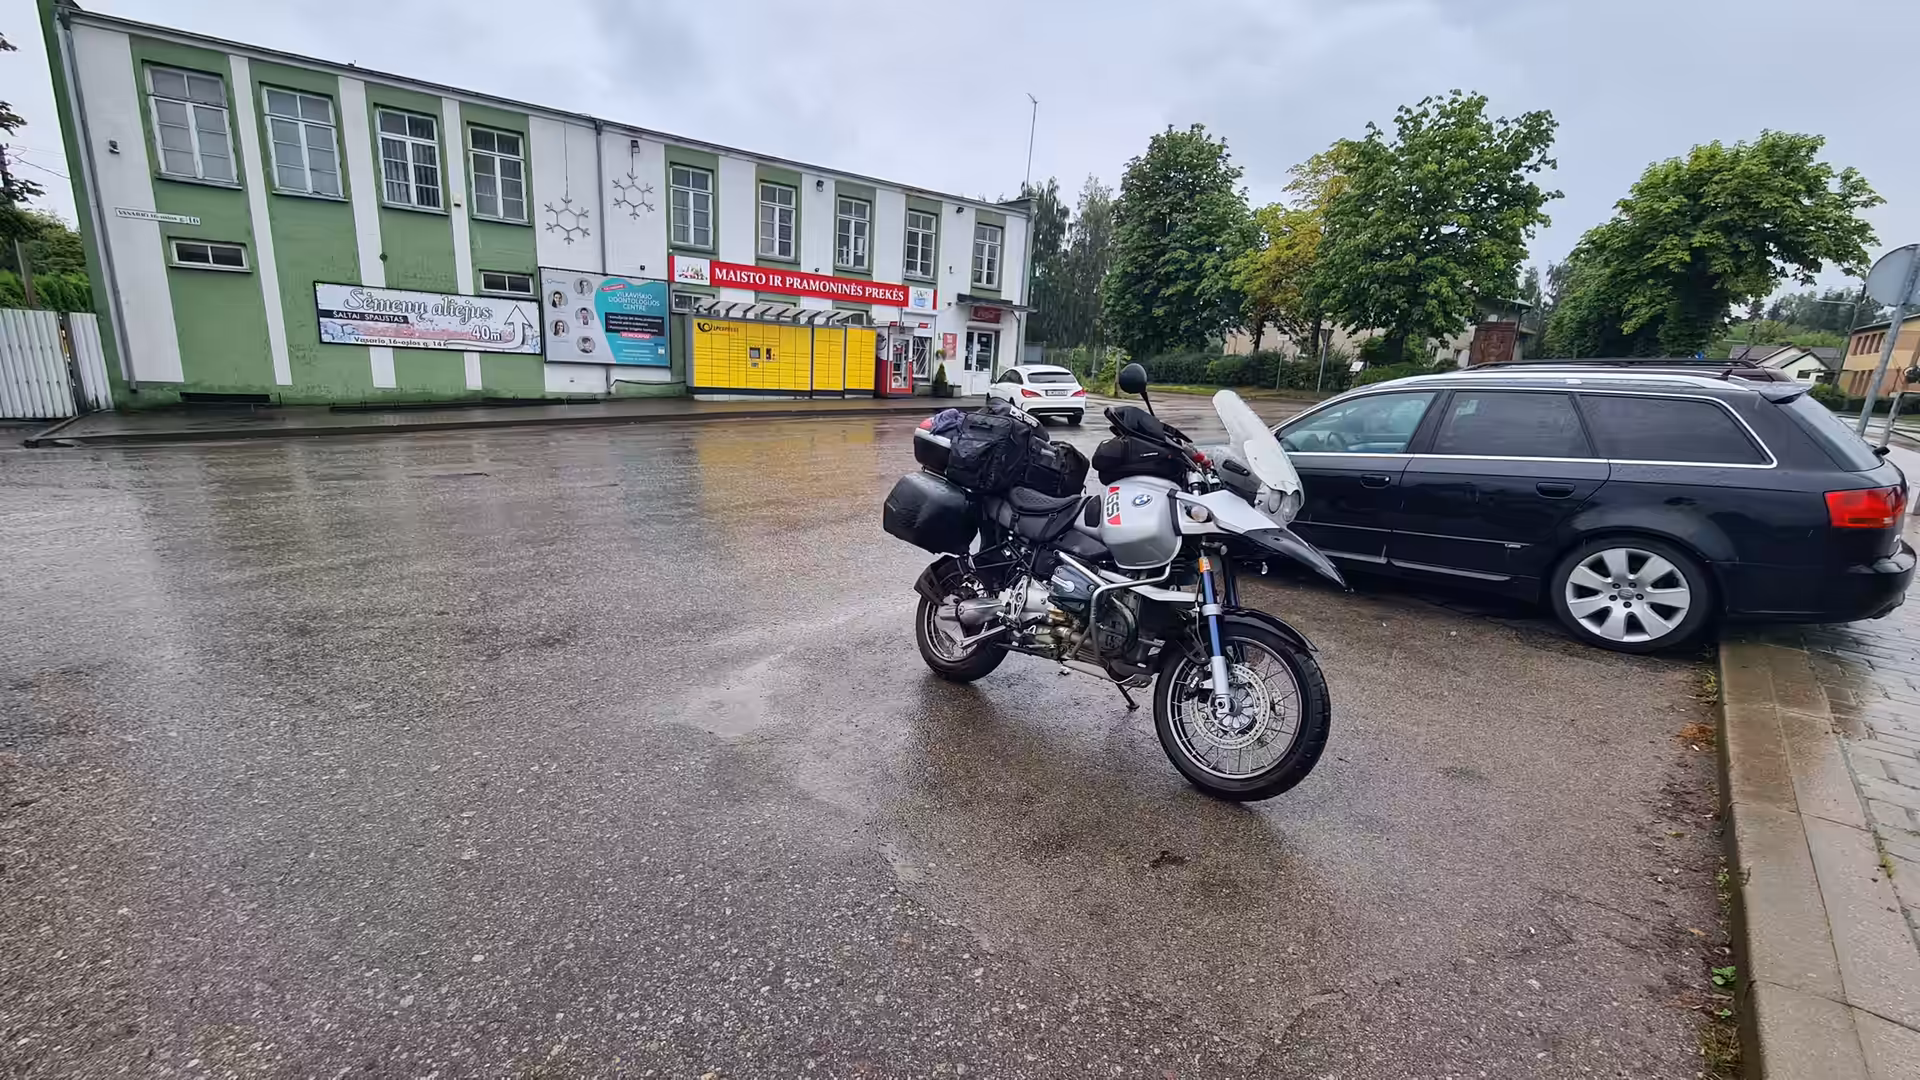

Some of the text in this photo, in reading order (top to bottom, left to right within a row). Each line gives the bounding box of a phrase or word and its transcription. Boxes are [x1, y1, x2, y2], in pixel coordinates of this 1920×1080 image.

[714, 267, 904, 302] MAISTO IR PRAMONINĖS PREKĖS
[332, 310, 404, 323] ŠALTAI SPAUSTAS
[344, 288, 493, 325] Sėmenų aliejus
[353, 336, 386, 344] Vasario
[388, 338, 421, 347] 16-osios
[471, 324, 502, 341] 40m
[1106, 492, 1120, 517] GS
